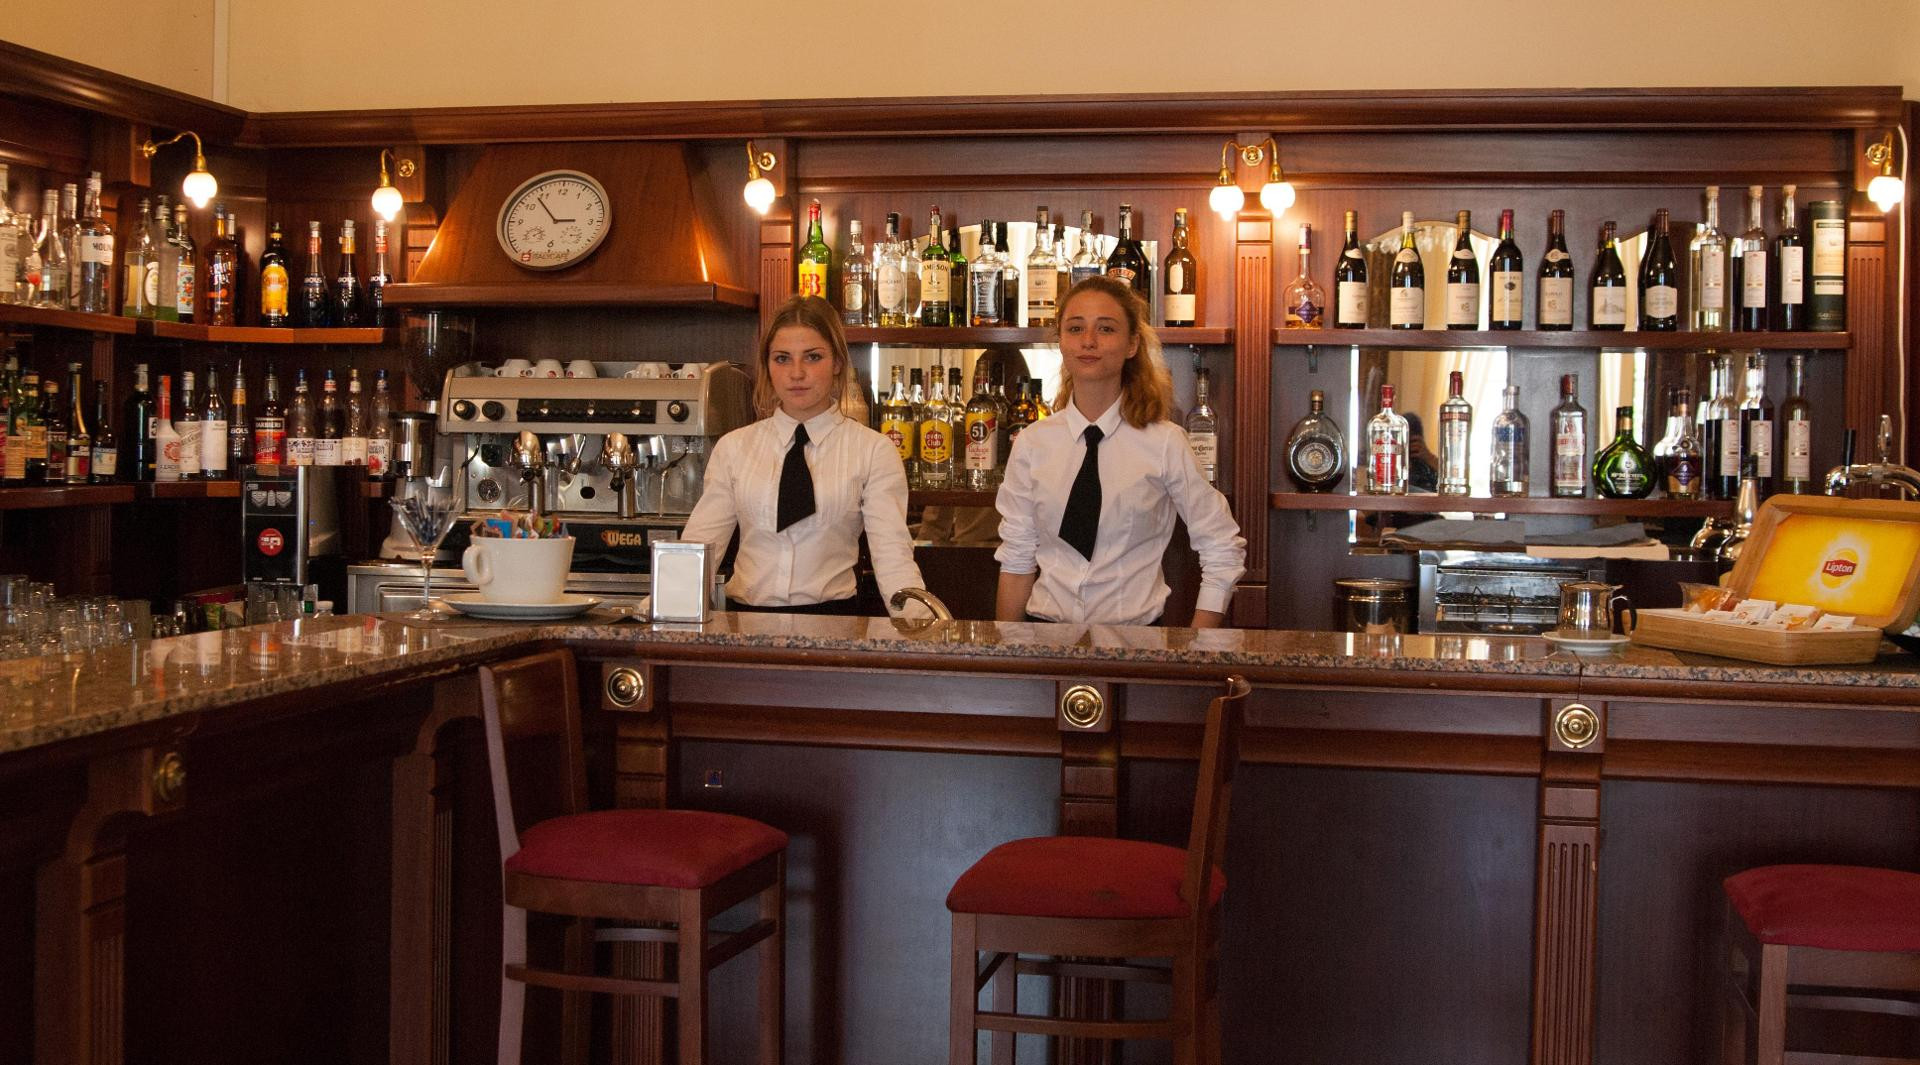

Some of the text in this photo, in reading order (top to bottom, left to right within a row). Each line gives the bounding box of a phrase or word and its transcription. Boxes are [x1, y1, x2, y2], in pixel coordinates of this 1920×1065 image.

[558, 188, 568, 196] 12
[547, 239, 554, 248] 6
[972, 425, 985, 438] 51
[606, 529, 642, 548] WEGA
[1825, 561, 1854, 575] Lipton
